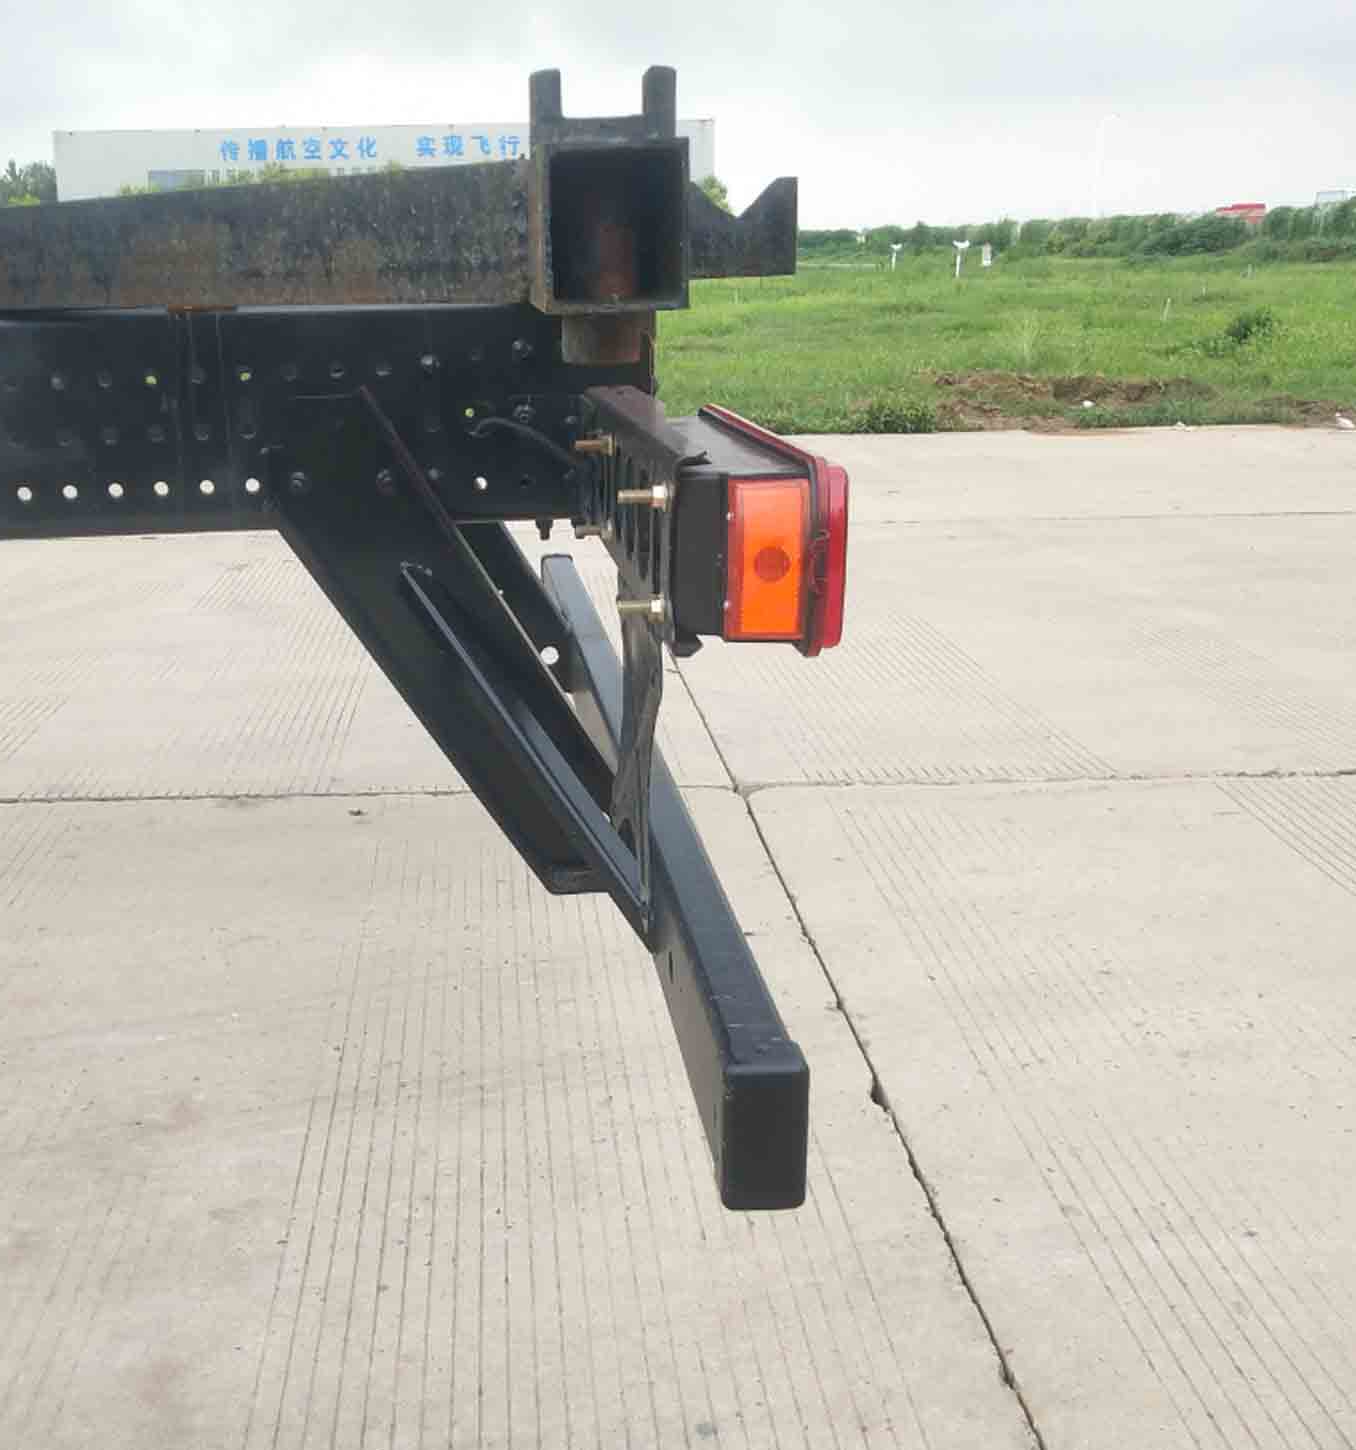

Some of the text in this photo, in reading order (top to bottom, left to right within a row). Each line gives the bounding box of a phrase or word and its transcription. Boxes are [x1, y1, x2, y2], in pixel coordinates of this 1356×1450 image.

[219, 135, 521, 161] 传播航空文化 实现飞行
